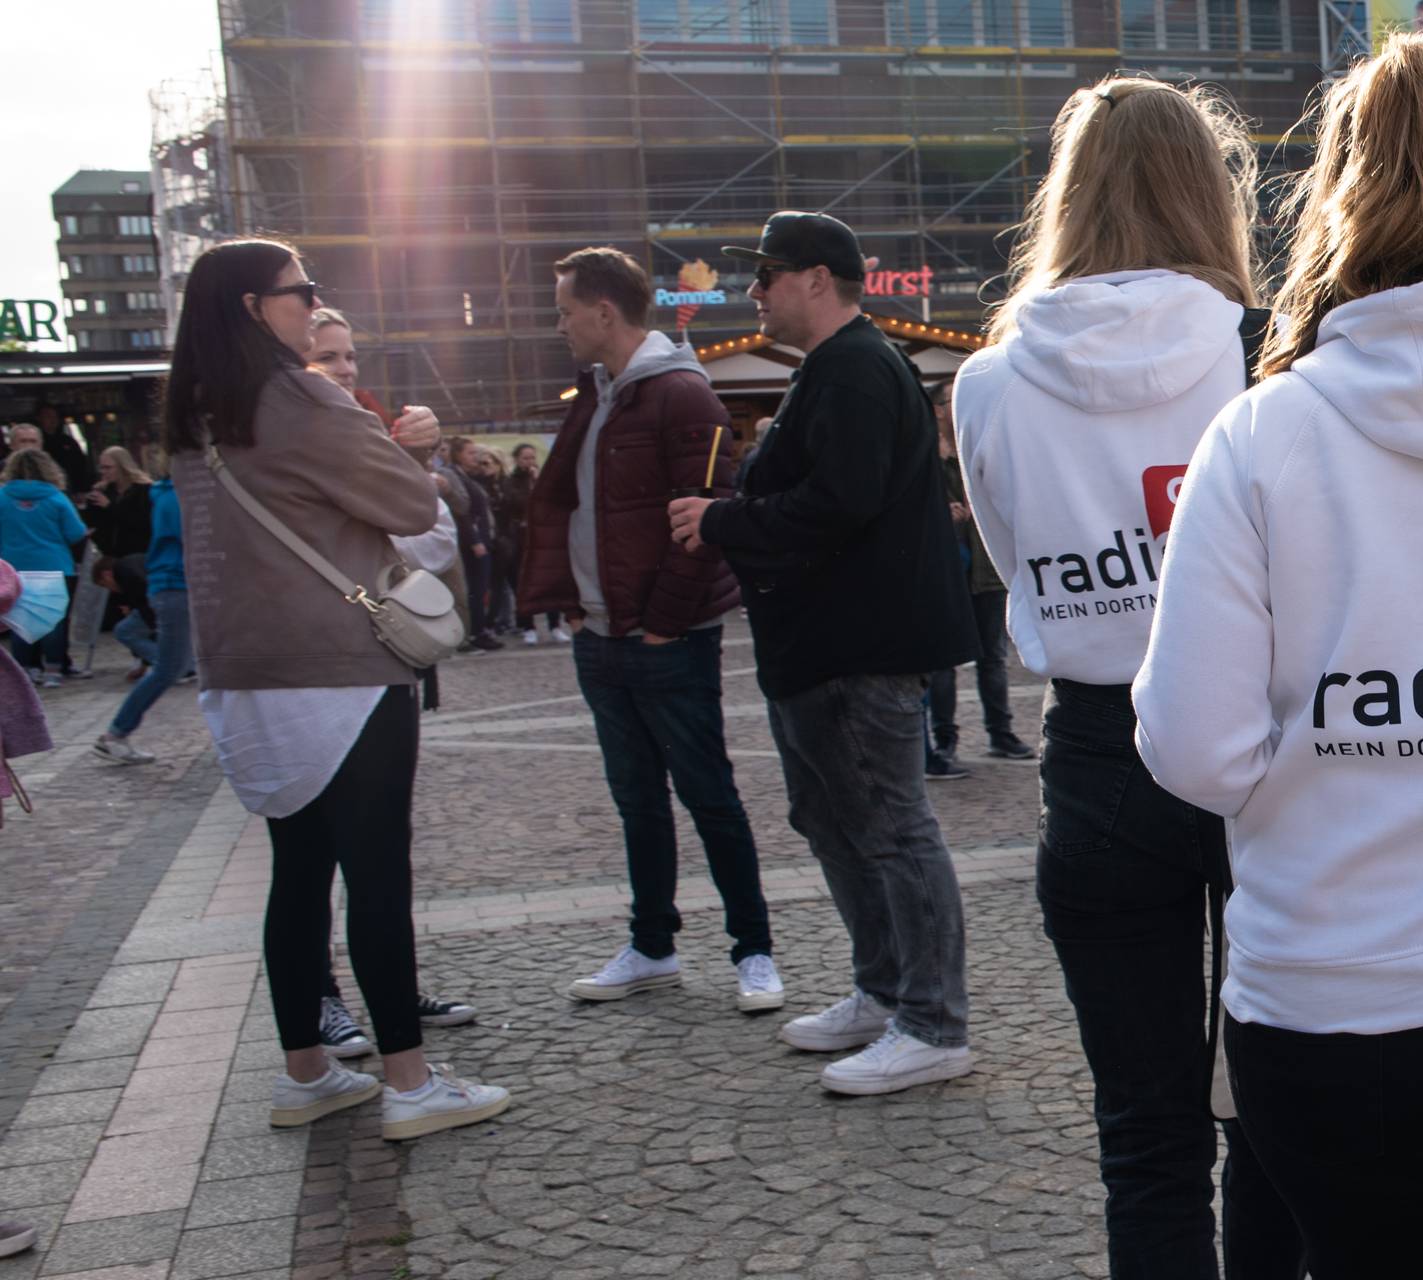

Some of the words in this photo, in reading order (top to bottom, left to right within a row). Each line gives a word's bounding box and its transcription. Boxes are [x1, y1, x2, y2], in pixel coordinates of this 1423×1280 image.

[864, 263, 934, 296] urst
[655, 288, 727, 306] Pommes
[1027, 528, 1168, 597] radi
[1040, 602, 1089, 621] MEIN
[1314, 741, 1385, 757] MEIN
